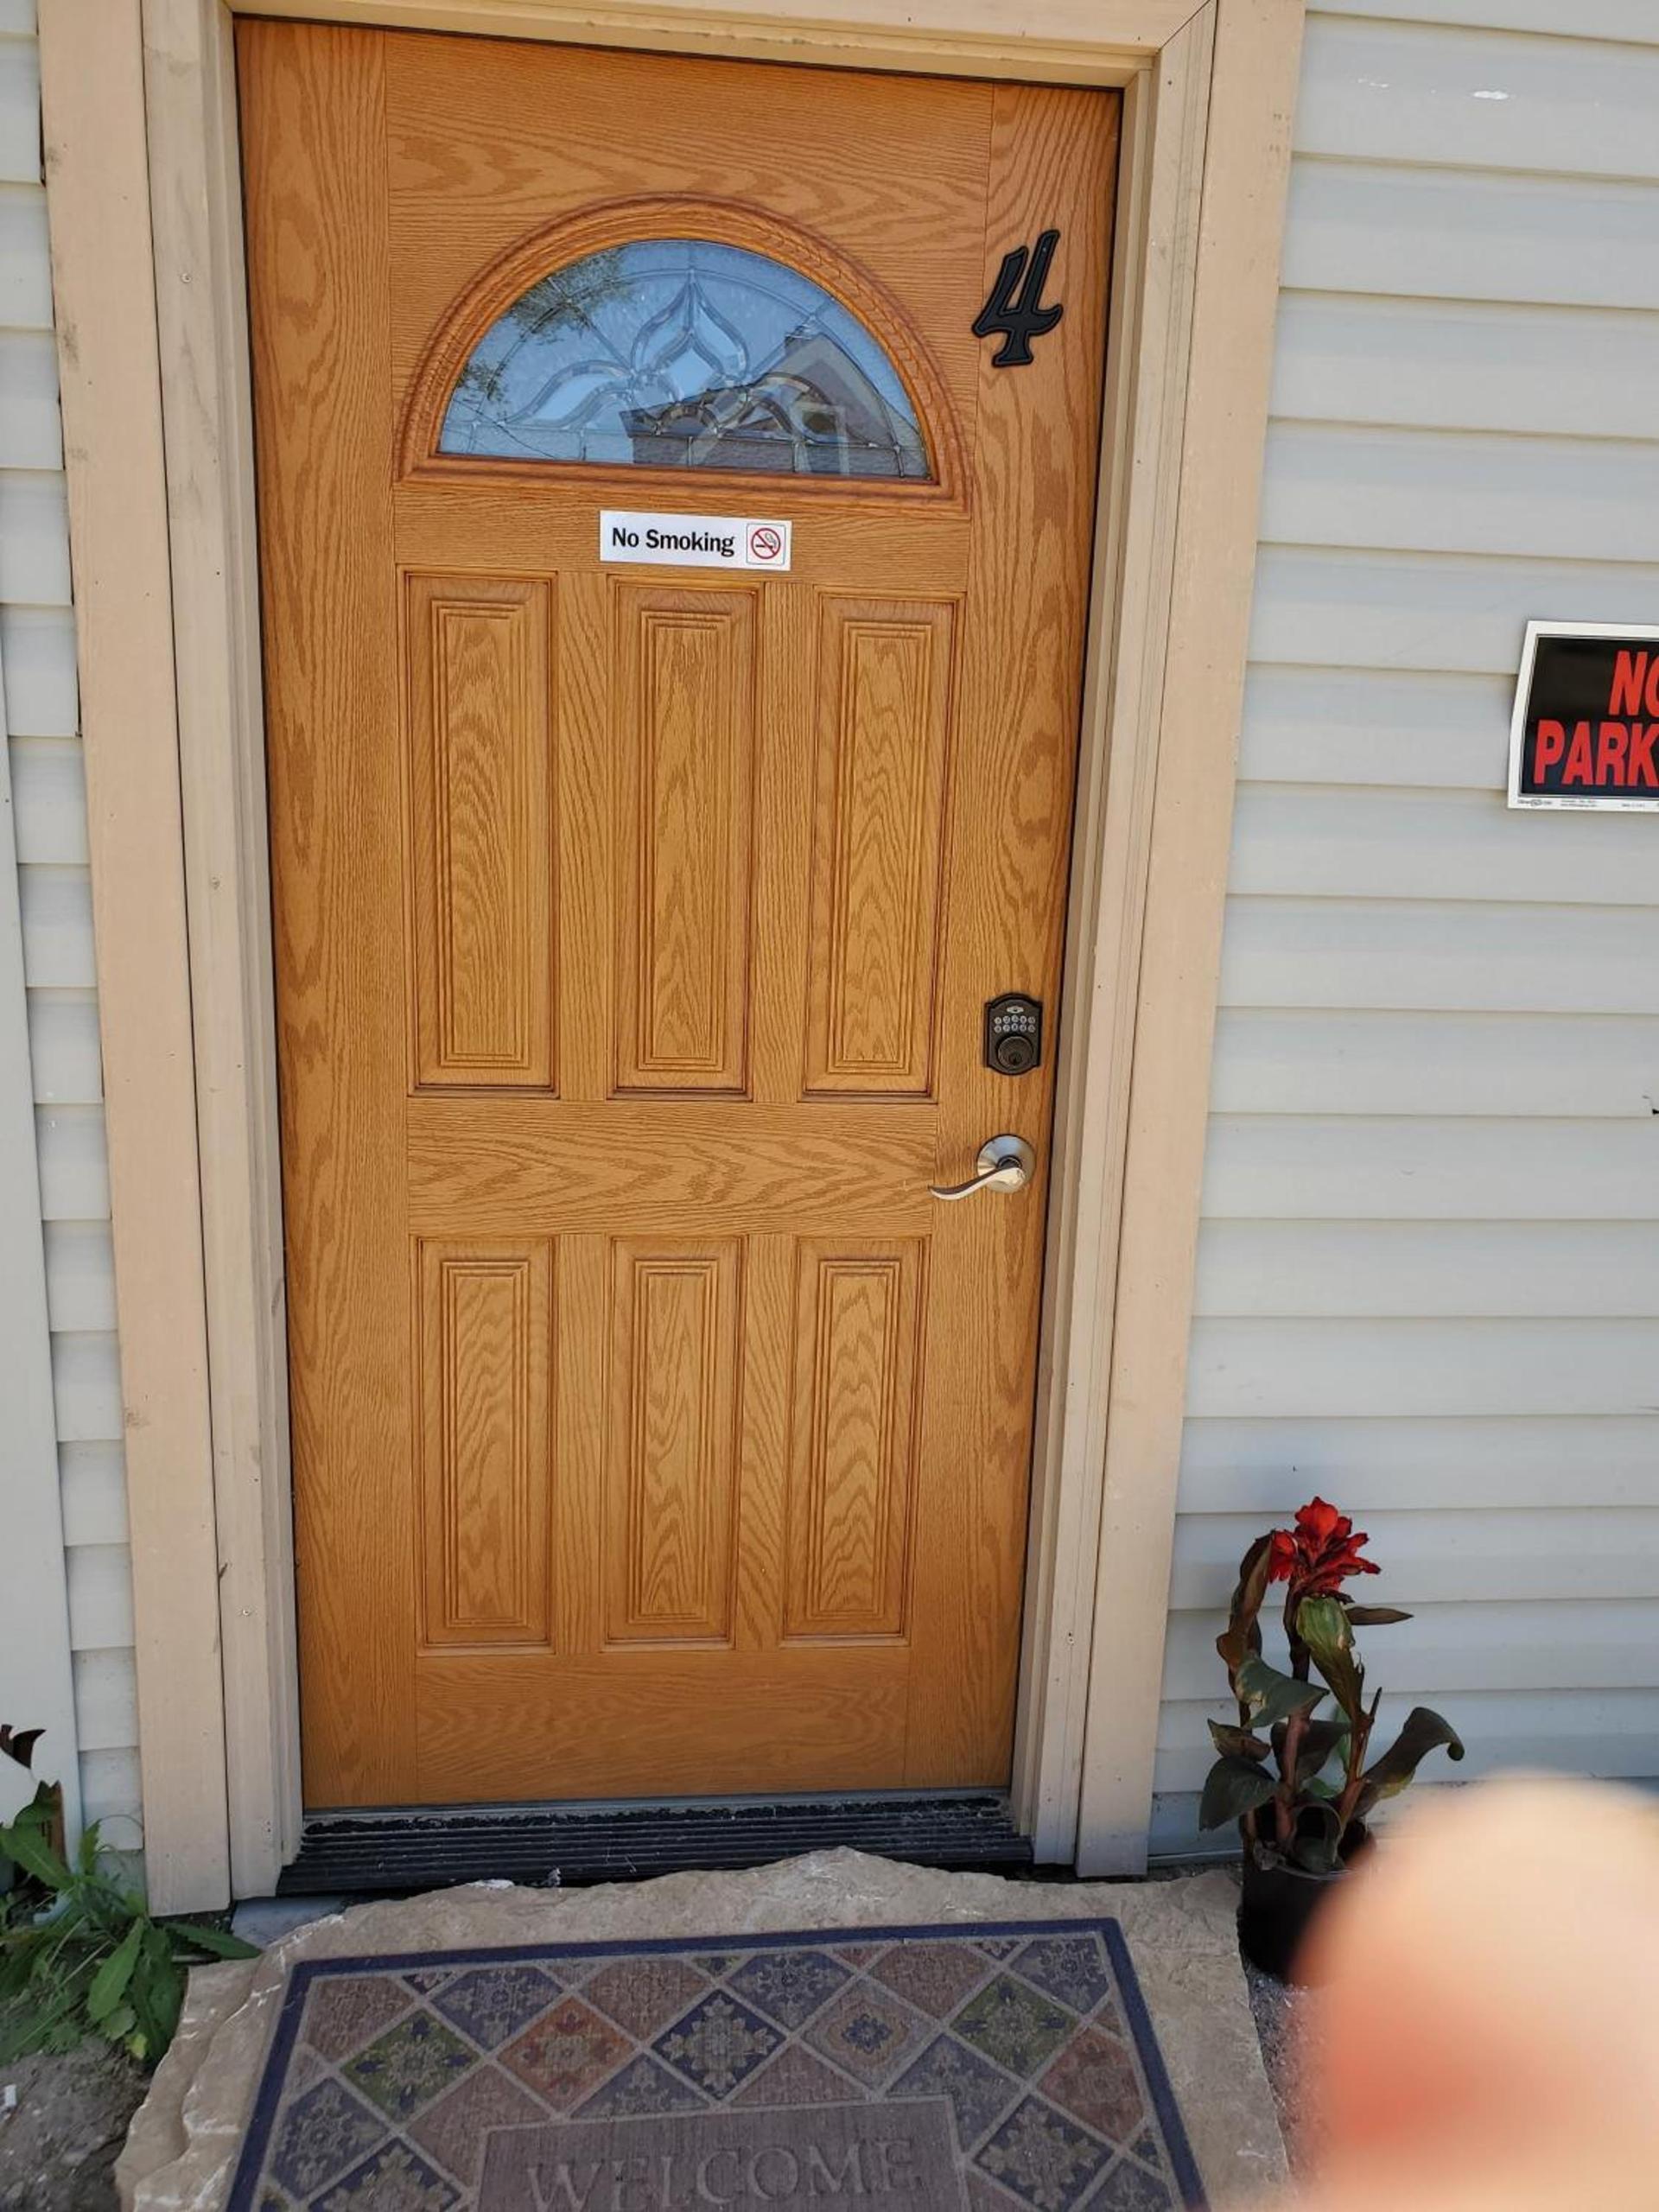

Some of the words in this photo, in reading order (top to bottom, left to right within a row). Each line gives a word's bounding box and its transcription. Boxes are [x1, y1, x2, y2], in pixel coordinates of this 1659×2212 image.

[971, 229, 1064, 367] 4
[612, 527, 639, 548] No
[645, 528, 734, 557] Smoking
[1533, 719, 1659, 787] PARK
[525, 2138, 921, 2212] WELCOME
